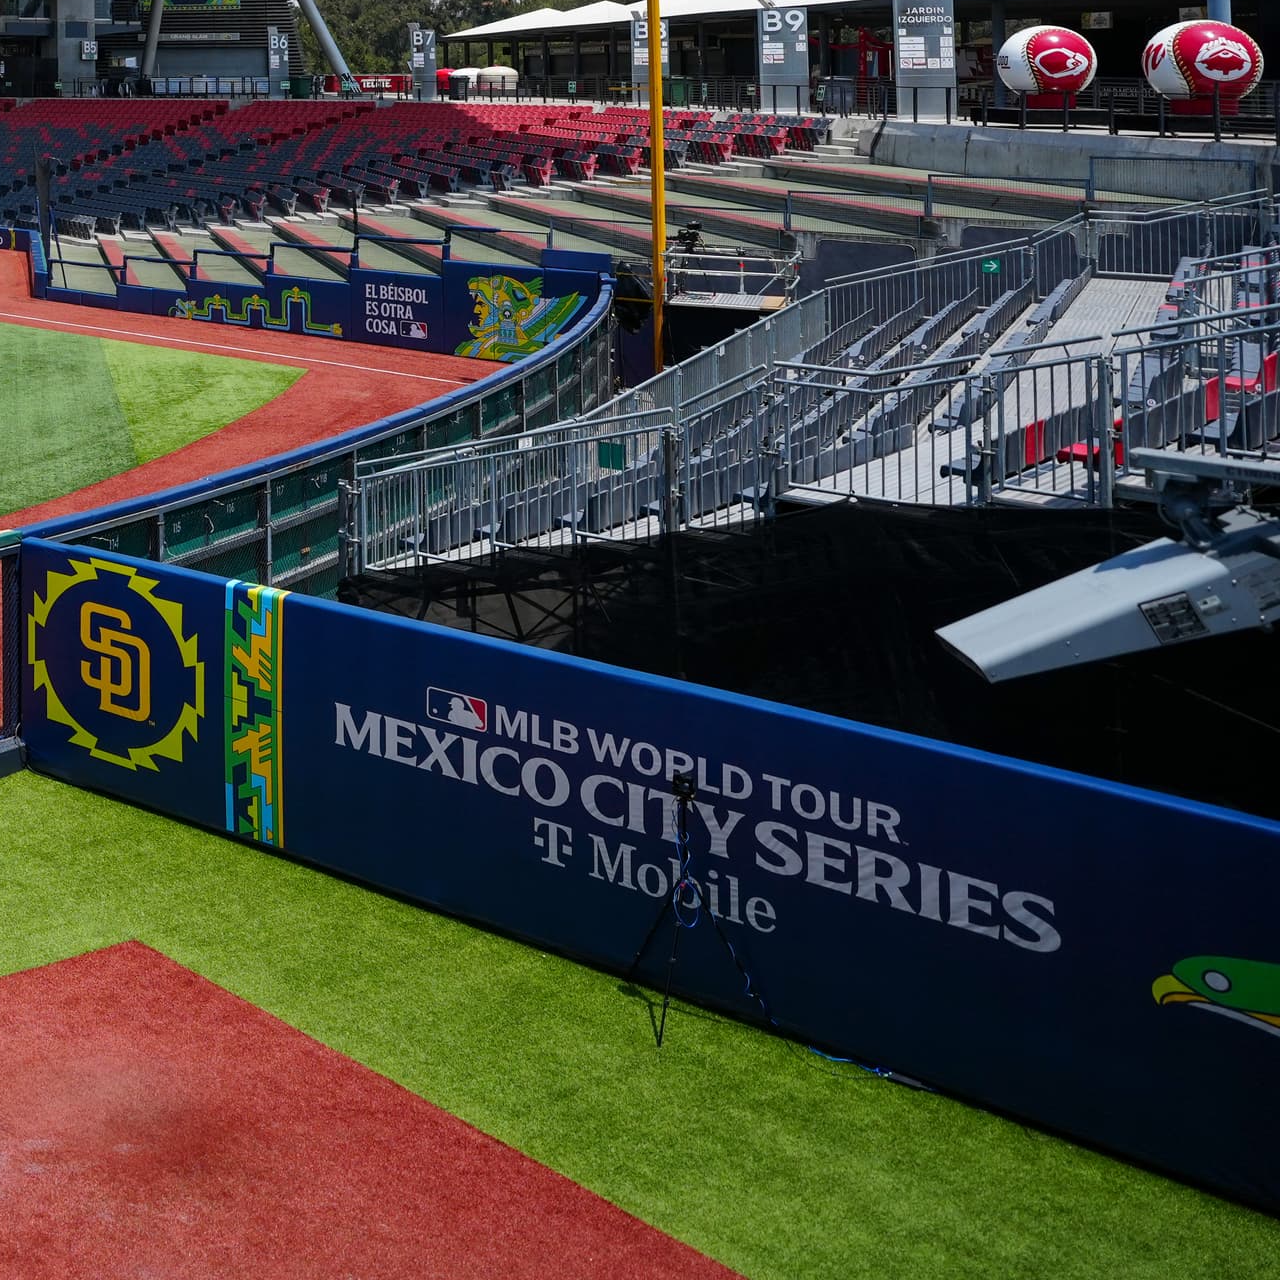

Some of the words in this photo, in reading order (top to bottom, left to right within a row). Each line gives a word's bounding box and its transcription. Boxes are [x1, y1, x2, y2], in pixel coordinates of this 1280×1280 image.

[906, 6, 944, 14] JARDIN
[763, 10, 805, 32] B9
[898, 16, 952, 24] IZQUIERDO
[84, 41, 96, 53] B5
[270, 36, 288, 49] B6
[413, 32, 434, 46] B7
[365, 284, 378, 298] EL
[380, 283, 428, 304] BÉISBOL
[365, 301, 379, 316] ES
[380, 303, 413, 320] OTRA
[366, 318, 397, 336] COSA
[80, 601, 150, 722] SD
[496, 704, 580, 754] MLB
[587, 728, 753, 800] WORLD
[762, 772, 902, 844] TOUR
[334, 702, 570, 808] MEXICO
[580, 774, 746, 859] CITY
[754, 820, 1062, 953] SERIES
